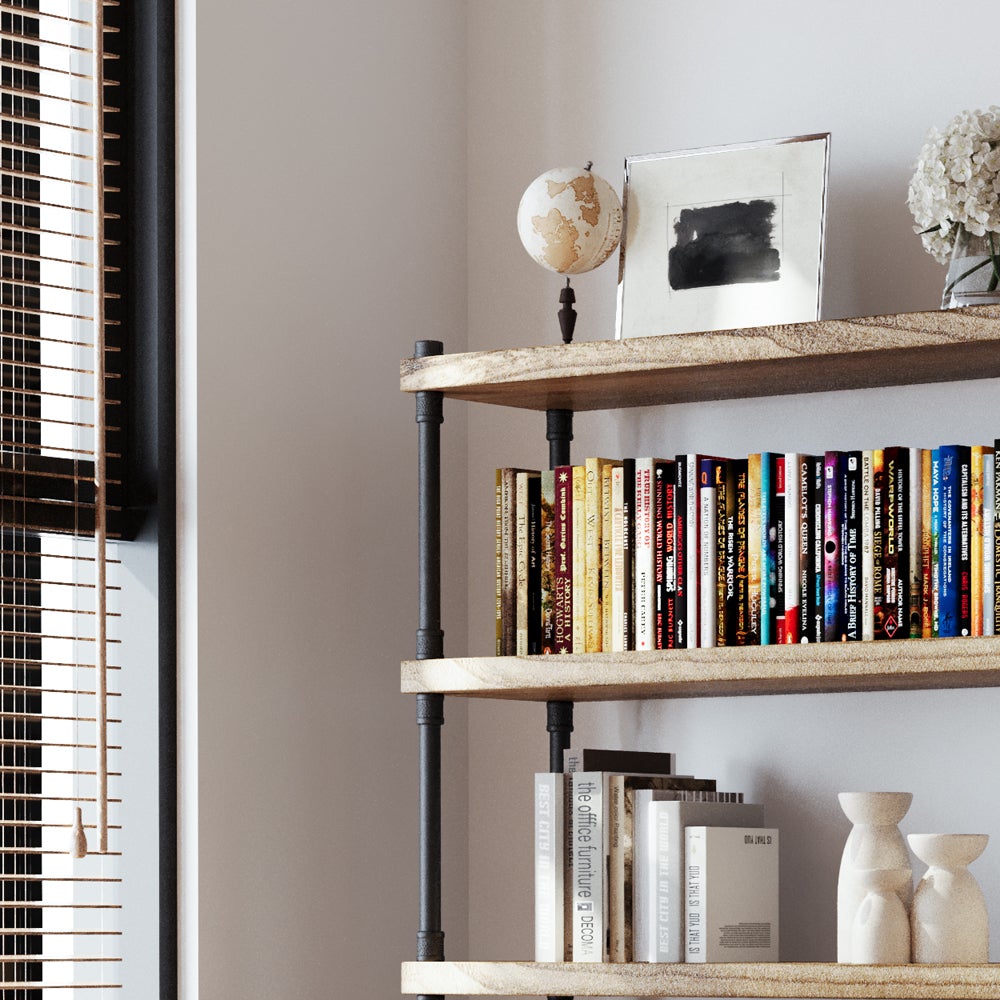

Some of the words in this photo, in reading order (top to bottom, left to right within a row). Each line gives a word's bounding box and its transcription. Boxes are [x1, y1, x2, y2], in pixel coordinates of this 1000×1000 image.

[578, 782, 595, 801] the
[578, 846, 595, 897] furniture
[689, 930, 699, 944] THAT
